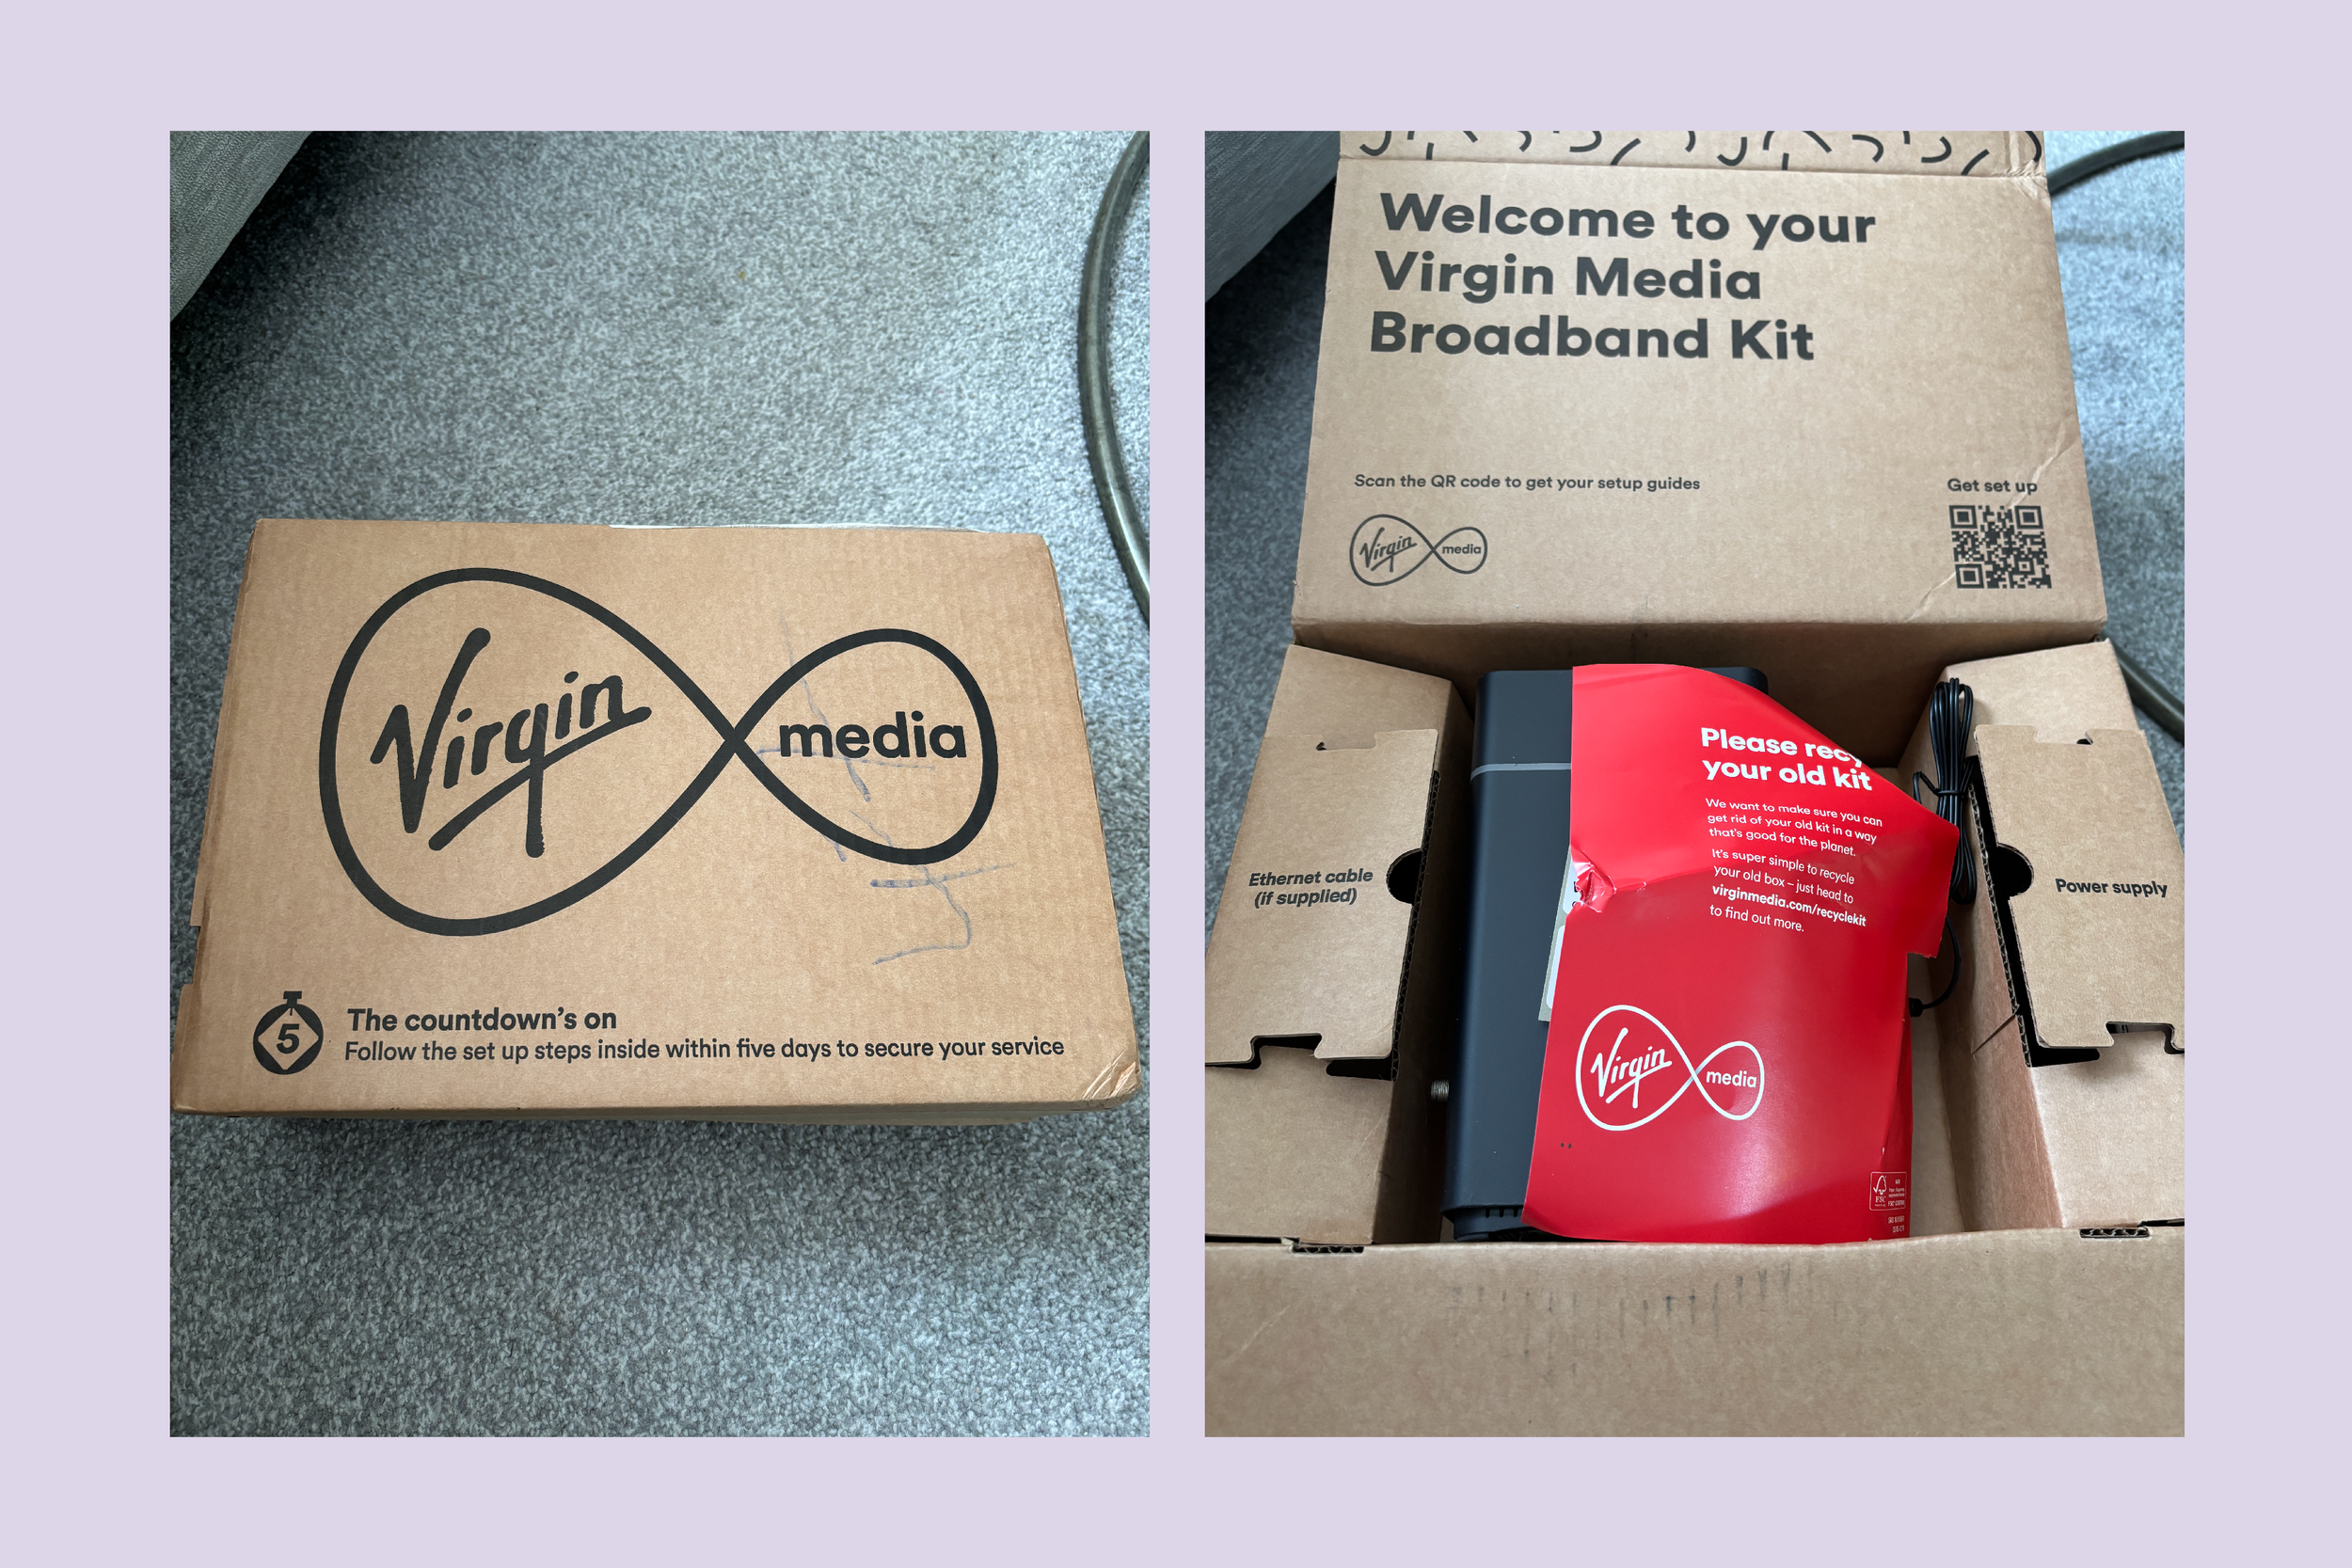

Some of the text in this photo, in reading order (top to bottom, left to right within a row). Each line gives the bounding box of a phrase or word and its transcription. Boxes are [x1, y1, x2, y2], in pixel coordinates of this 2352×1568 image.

[1380, 192, 1876, 251] Welcome to your
[1374, 250, 1762, 306] Virgin Media
[1370, 311, 1815, 361] Broadband Kit
[1354, 474, 1701, 492] Scan the QR code to get your setup guides
[1947, 478, 2038, 496] Get set up
[1359, 527, 1482, 573] Virgin media
[371, 627, 966, 858] Virgin media
[1701, 727, 1798, 755] Please
[1702, 760, 1872, 791] your old kit
[1706, 798, 1883, 827] We want to make sure you can
[1708, 815, 1877, 845] get rid of your old kit in a way
[1708, 828, 1856, 857] that’s good for the planet.
[1248, 868, 1374, 887] Ethernet cable
[1711, 848, 1855, 885] It’s super simple to recycle
[1254, 888, 1358, 909] (if supplied)
[1713, 865, 1740, 877] your
[1742, 869, 1761, 882] old
[1764, 872, 1786, 888] box
[1795, 879, 1814, 895] just
[1816, 884, 1842, 902] head
[1843, 892, 1853, 904] to
[2055, 879, 2168, 898] Power supply
[1709, 904, 1804, 932] to find out more.
[1712, 883, 1867, 927] virginmedia.com/recyclekit
[347, 1006, 616, 1031] The countdown’s on
[277, 1023, 300, 1053] 5
[345, 1036, 1064, 1065] Follow the set up steps inside within five days to secure your service
[1591, 1027, 1757, 1109] Virgin media
